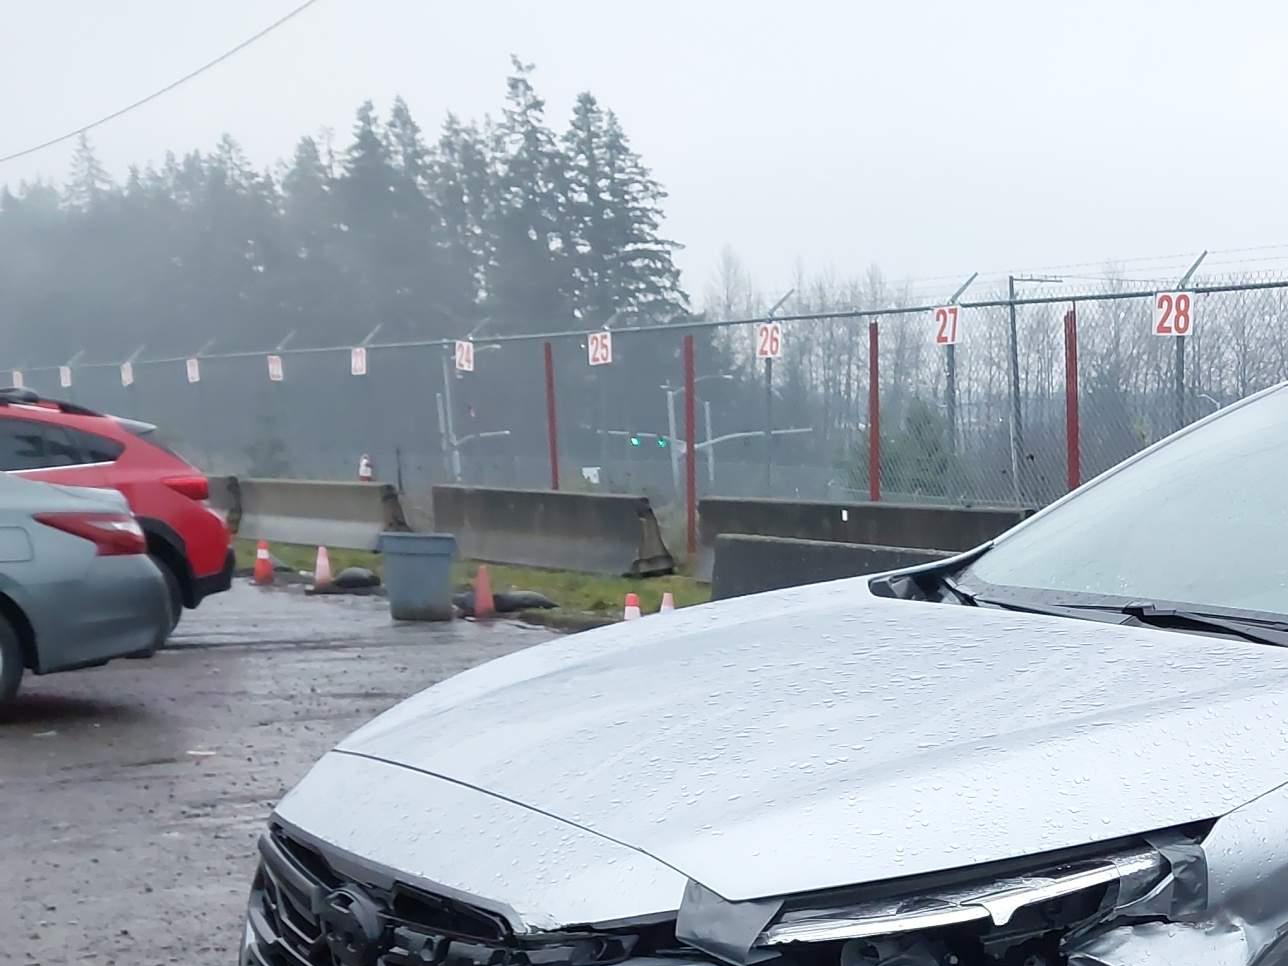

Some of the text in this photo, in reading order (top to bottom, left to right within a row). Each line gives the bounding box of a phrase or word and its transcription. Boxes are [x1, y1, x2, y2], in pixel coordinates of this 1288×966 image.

[935, 308, 958, 344] 27
[1156, 294, 1190, 334] 28
[590, 335, 609, 363] 25
[759, 326, 779, 356] 26
